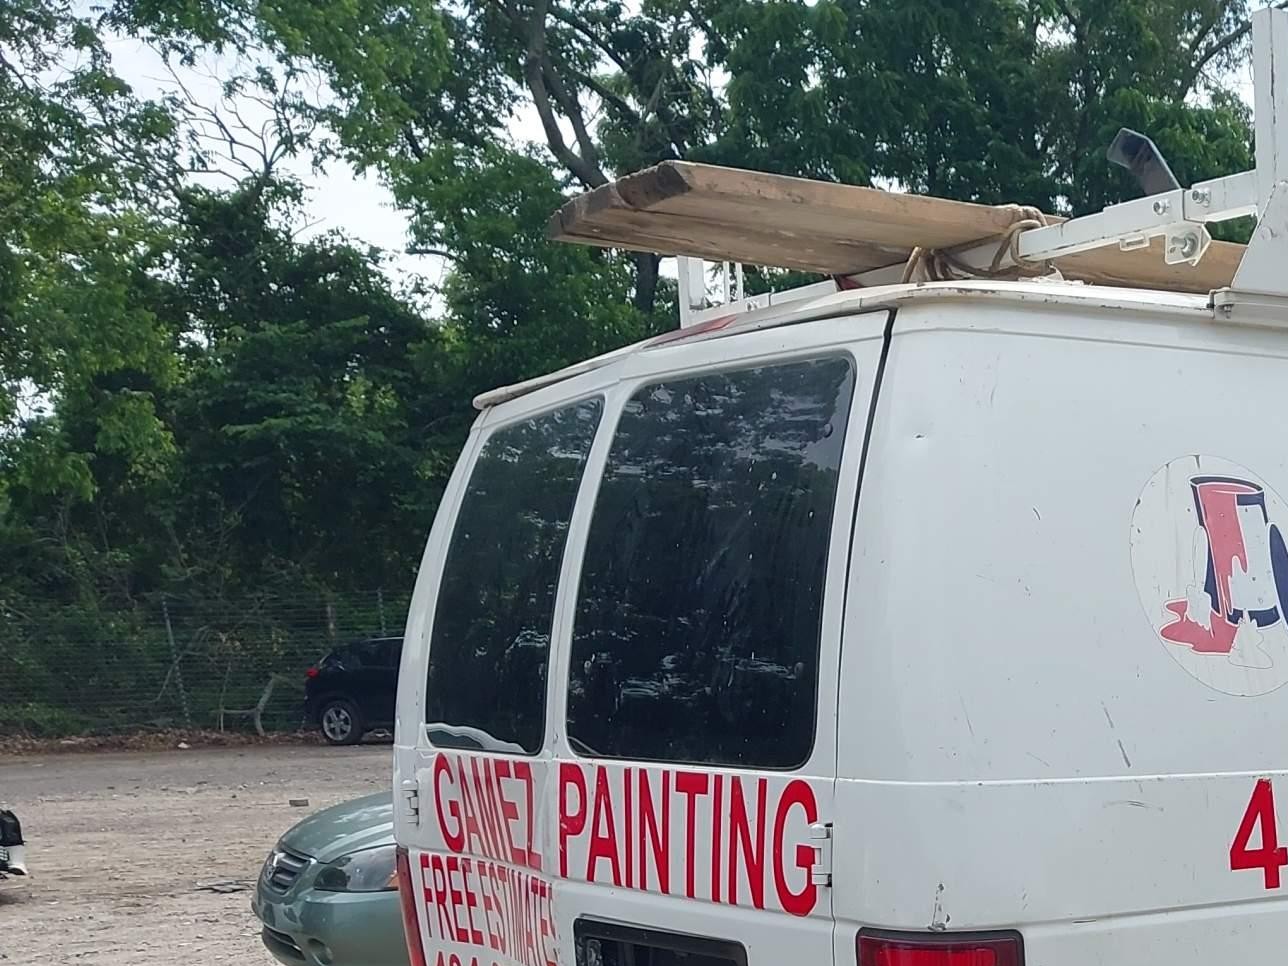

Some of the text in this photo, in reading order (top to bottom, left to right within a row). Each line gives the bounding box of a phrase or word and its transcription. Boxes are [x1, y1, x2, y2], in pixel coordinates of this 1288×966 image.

[419, 852, 485, 946] FREE
[433, 752, 819, 918] GAMEZ PAINTING
